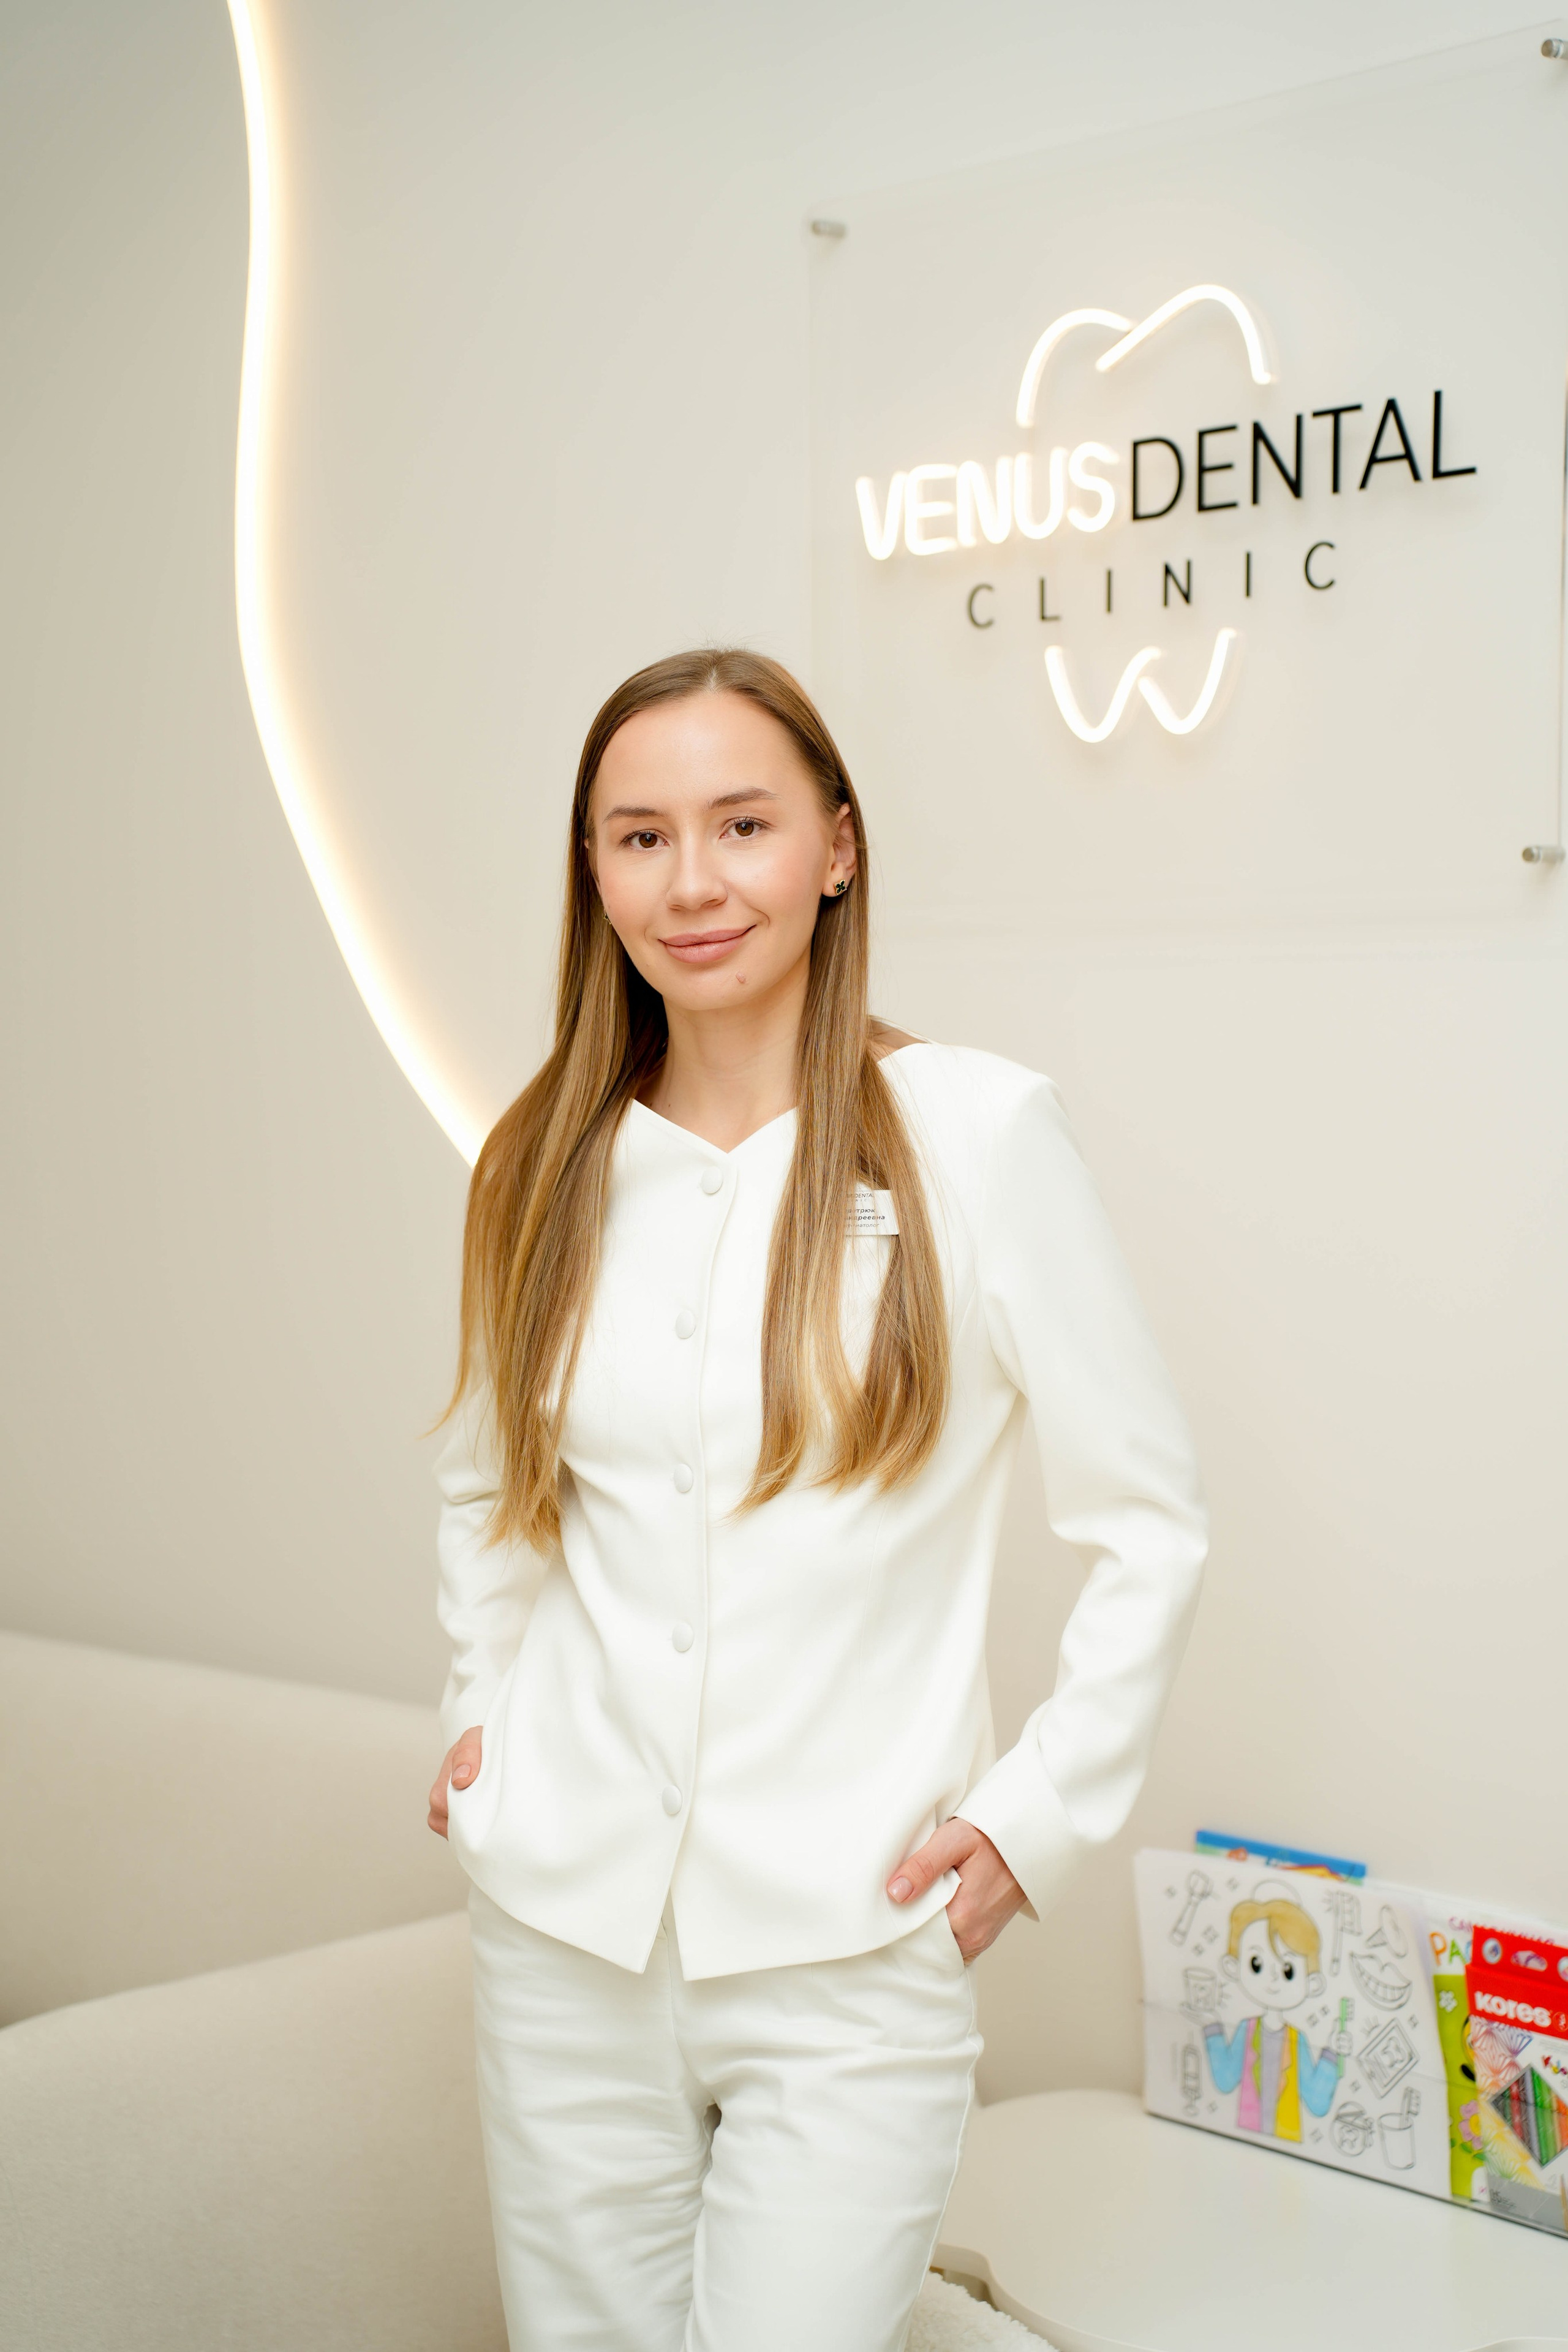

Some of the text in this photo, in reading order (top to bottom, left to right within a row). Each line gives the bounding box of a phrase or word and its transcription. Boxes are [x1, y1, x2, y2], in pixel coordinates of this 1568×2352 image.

[856, 390, 1477, 560] VENUS DENTAL
[968, 541, 1335, 628] CLINIC
